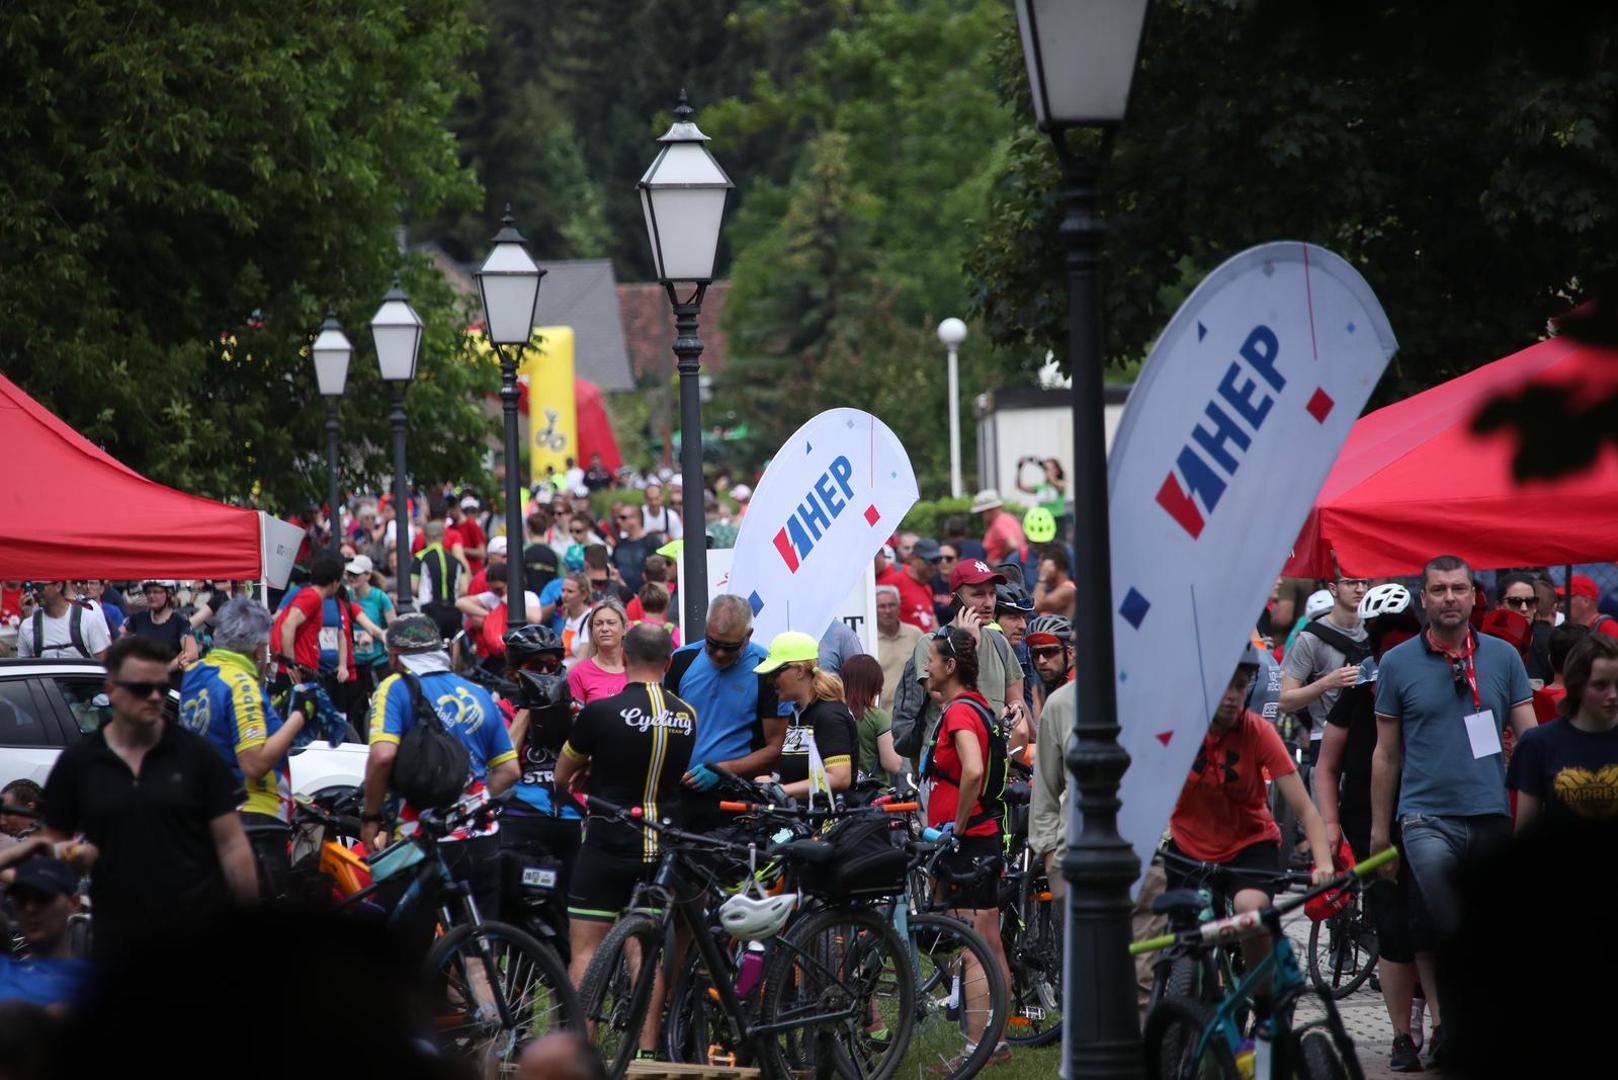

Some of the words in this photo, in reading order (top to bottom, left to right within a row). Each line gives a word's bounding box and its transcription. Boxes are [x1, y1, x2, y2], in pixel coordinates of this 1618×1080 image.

[1190, 324, 1287, 478] HEP
[796, 455, 855, 542] HEP
[620, 708, 692, 736] Cycling
